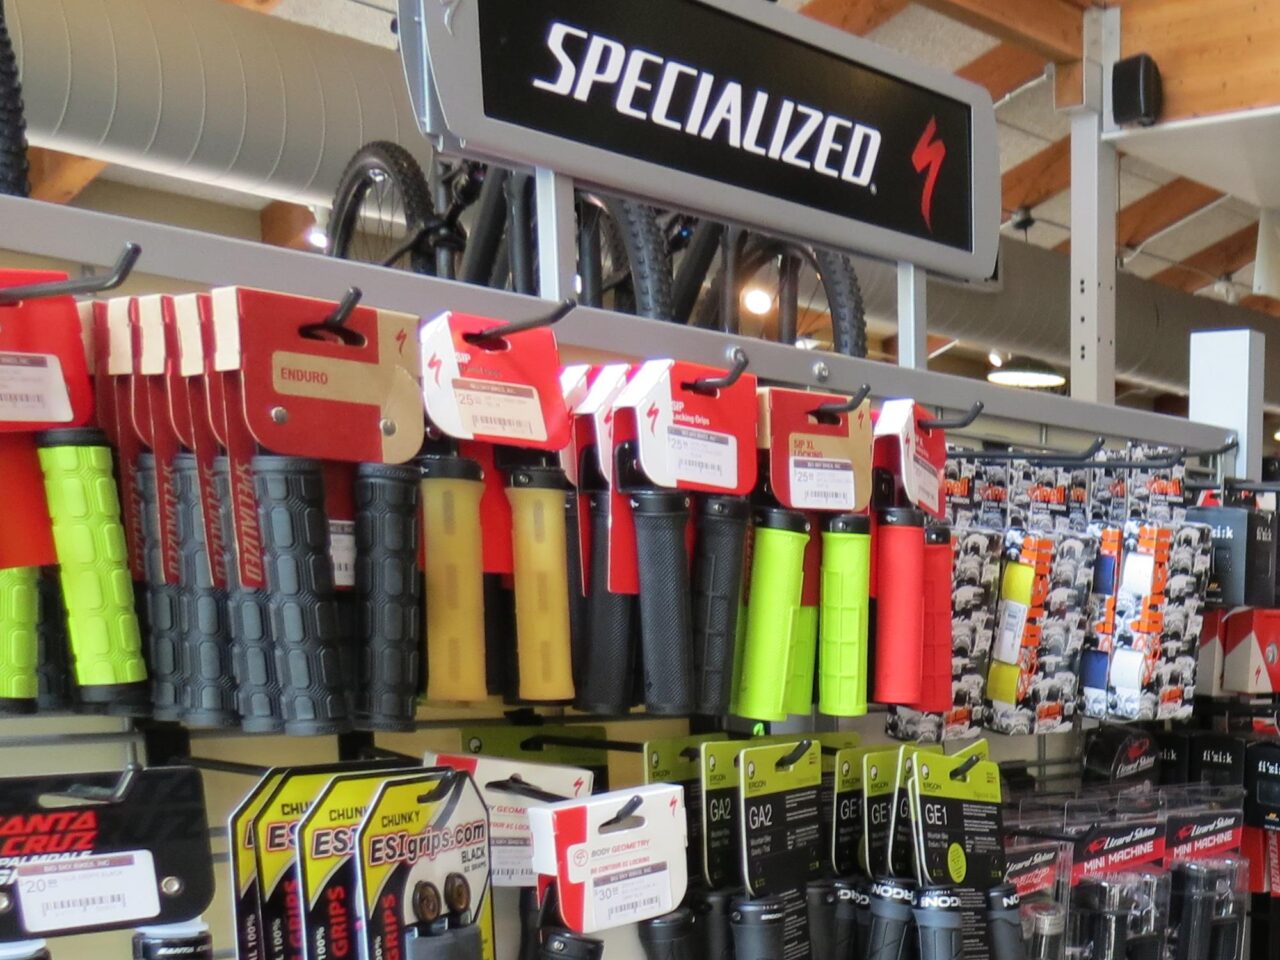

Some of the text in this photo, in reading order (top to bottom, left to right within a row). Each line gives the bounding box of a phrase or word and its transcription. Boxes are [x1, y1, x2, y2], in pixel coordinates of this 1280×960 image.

[532, 21, 882, 188] SPECIALIZED
[280, 366, 329, 386] ENDURO
[235, 462, 263, 582] SPECIALIZED
[381, 810, 421, 829] CHUNKY
[709, 797, 732, 822] GA2
[748, 803, 773, 830] GA2
[924, 802, 948, 826] GE1
[0, 811, 98, 836] ANTA
[1190, 820, 1216, 838] Lizard
[2, 831, 98, 856] CRUZ
[369, 819, 486, 866] ESIgrips.com
[591, 839, 650, 858] BODY GEOMETRY
[1102, 834, 1134, 850] Lizard
[1173, 829, 1233, 858] MINI MACHINE
[460, 847, 486, 864] BLACK
[1083, 841, 1155, 874] MINI MACHINE
[246, 913, 257, 948] 100%
[326, 885, 350, 958] GRIPS
[272, 917, 284, 952] 100%
